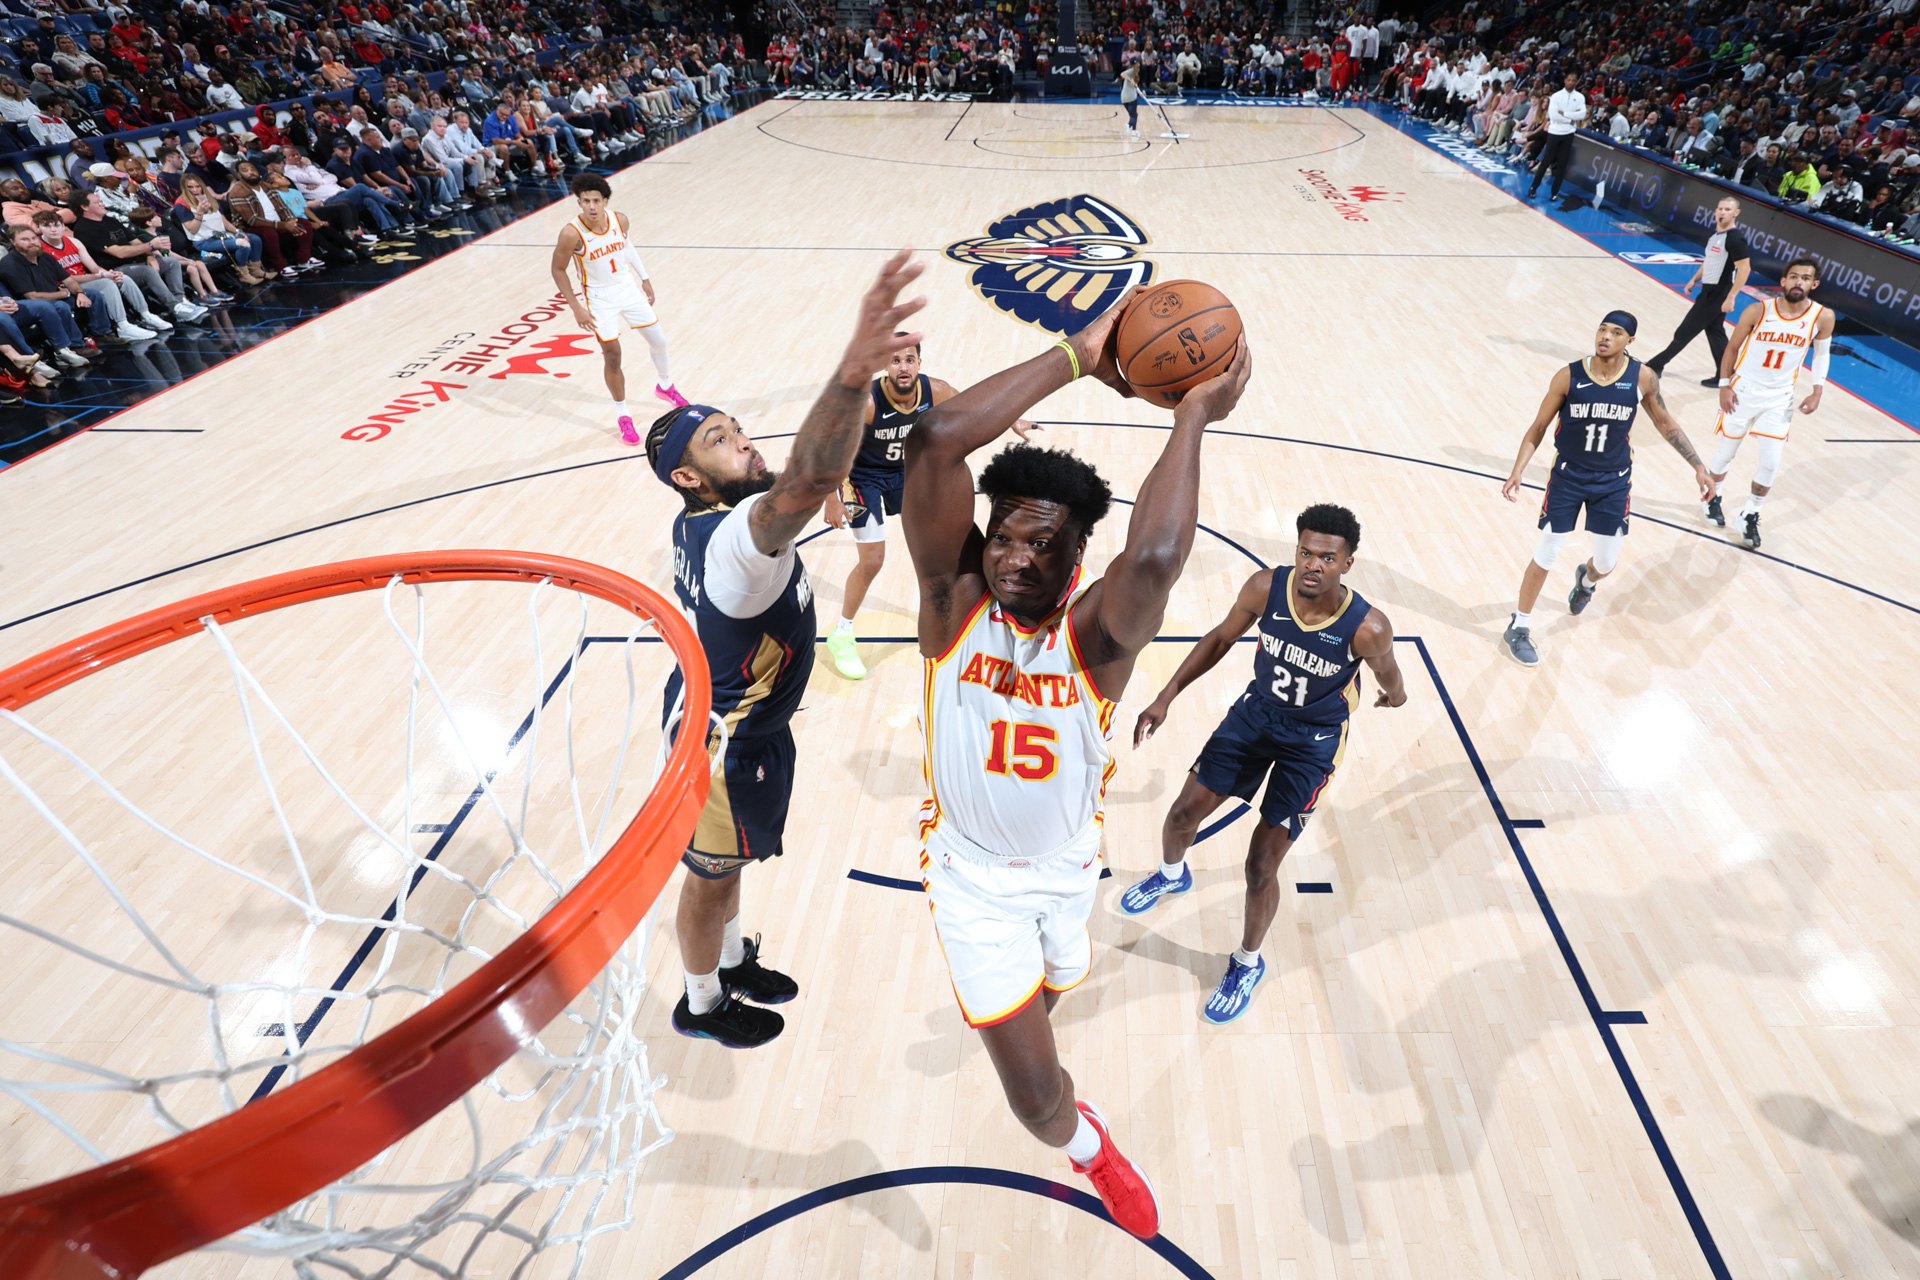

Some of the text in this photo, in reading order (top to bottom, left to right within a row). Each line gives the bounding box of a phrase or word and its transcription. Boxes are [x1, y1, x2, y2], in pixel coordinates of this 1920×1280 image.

[773, 91, 972, 101] PELICANS
[1588, 156, 1643, 198] SHIFT
[589, 241, 625, 261] ATLANTA
[1693, 205, 1775, 254] EXPNCE
[1774, 239, 1806, 262] THE
[1875, 283, 1907, 309] OF
[609, 258, 617, 273] 1
[1756, 332, 1807, 348] ATLANTA
[389, 332, 475, 379] CENTER
[1762, 349, 1786, 370] 11
[1569, 403, 1633, 421] NEW ORLEANS
[874, 427, 897, 440] NEW
[1584, 423, 1609, 453] 11
[885, 442, 905, 461] 5
[1283, 643, 1342, 678] ORLEANS
[960, 651, 1080, 709] ATLANTA
[1271, 664, 1308, 707] 21
[985, 718, 1059, 782] 15
